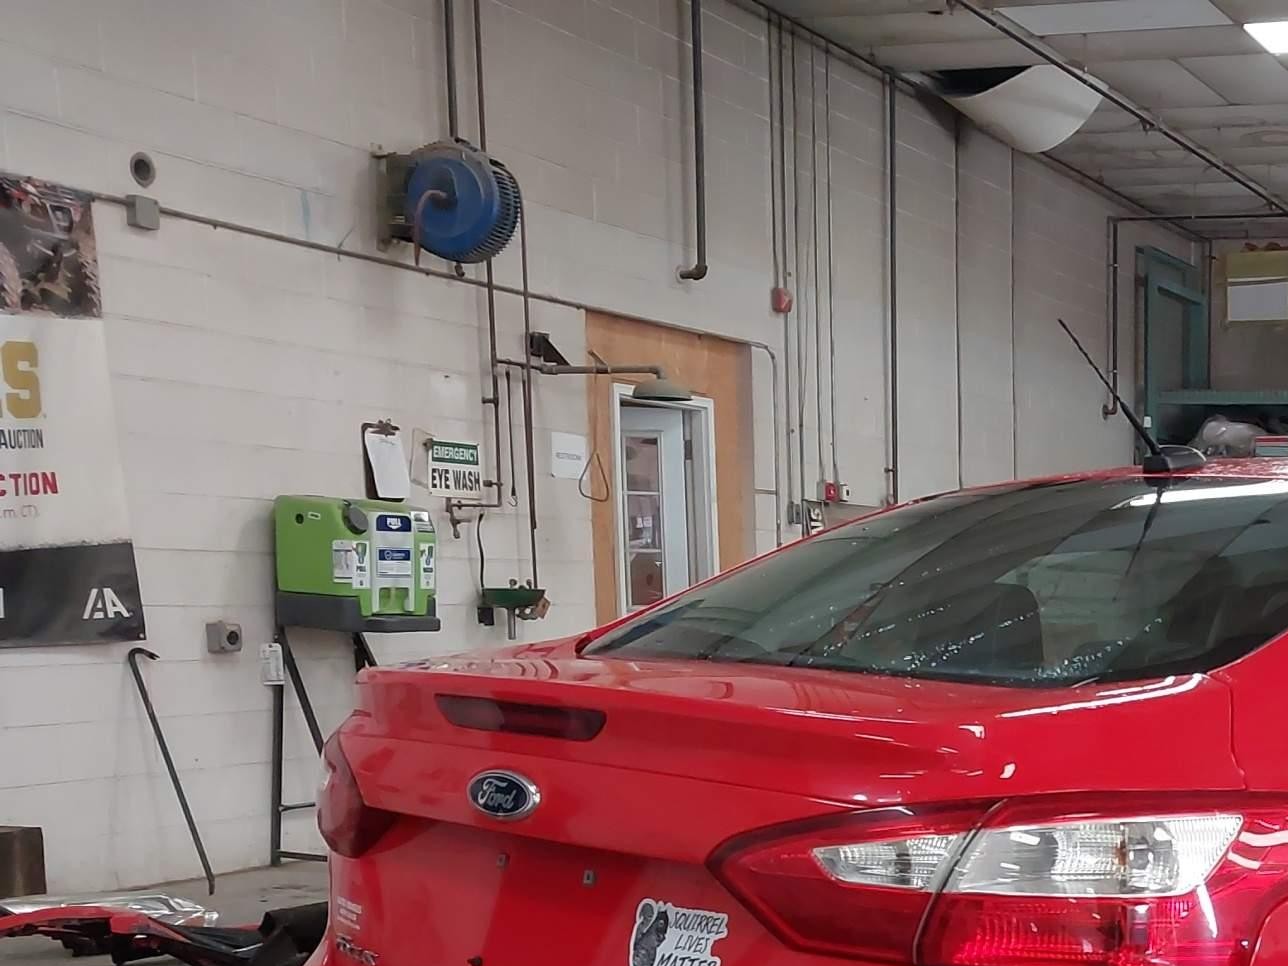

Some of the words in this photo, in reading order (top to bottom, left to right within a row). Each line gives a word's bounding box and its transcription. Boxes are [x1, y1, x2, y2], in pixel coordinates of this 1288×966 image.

[0, 341, 42, 418] S
[433, 445, 477, 461] EMERGENCY
[431, 467, 451, 490] EYE
[451, 469, 482, 492] WASH
[477, 778, 517, 809] Ford
[669, 911, 727, 936] SQUIRREL
[674, 934, 711, 954] LIVES
